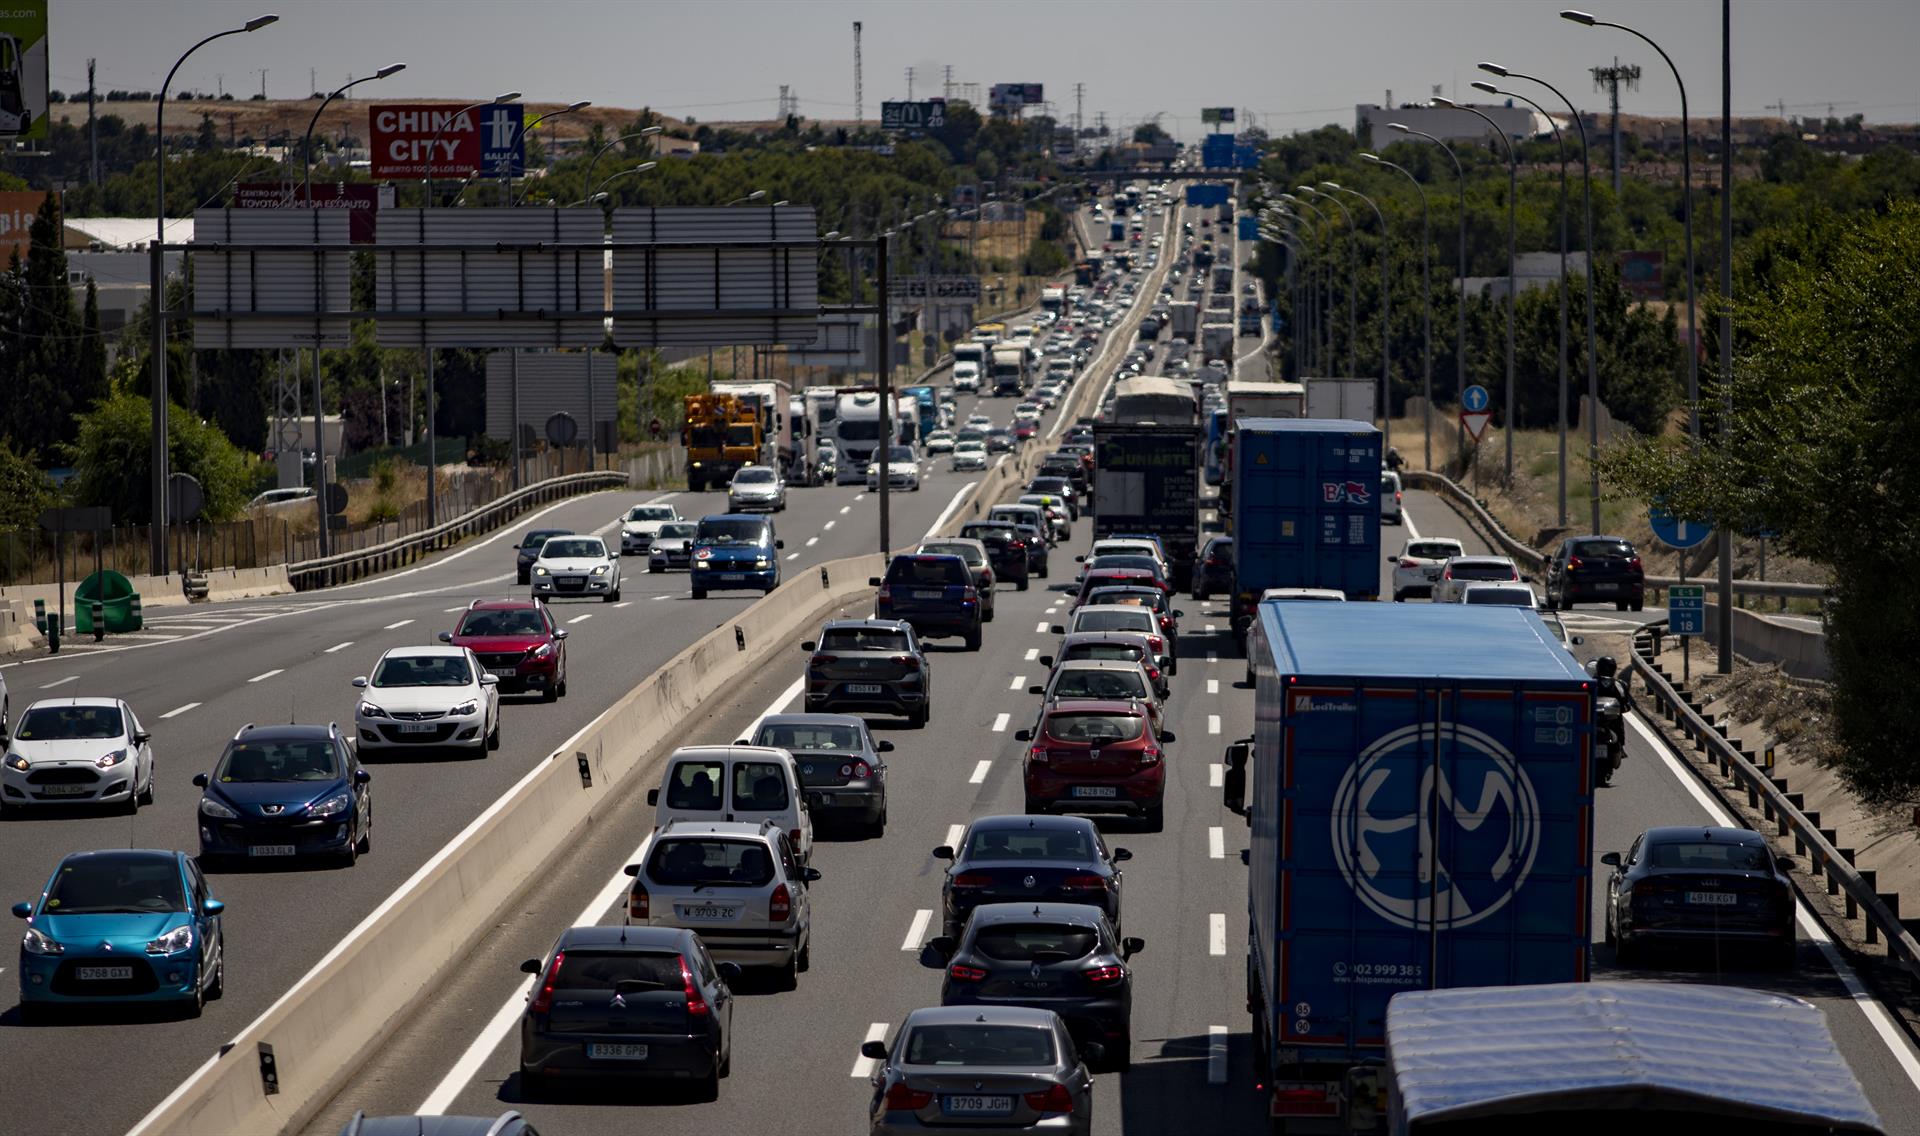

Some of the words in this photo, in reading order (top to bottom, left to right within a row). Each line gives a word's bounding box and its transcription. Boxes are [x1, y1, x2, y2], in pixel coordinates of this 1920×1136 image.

[376, 111, 474, 133] CHINA
[928, 116, 944, 127] 20
[389, 139, 461, 161] CITY
[1126, 453, 1192, 466] UNIARTE
[1680, 620, 1694, 631] 18
[721, 908, 734, 917] ZC
[82, 968, 108, 978] 5768
[1374, 964, 1398, 975] 999
[1296, 1005, 1309, 1015] 85
[1296, 1022, 1309, 1032] 90
[954, 1098, 983, 1109] 3709
[986, 1098, 1009, 1109] JGH
